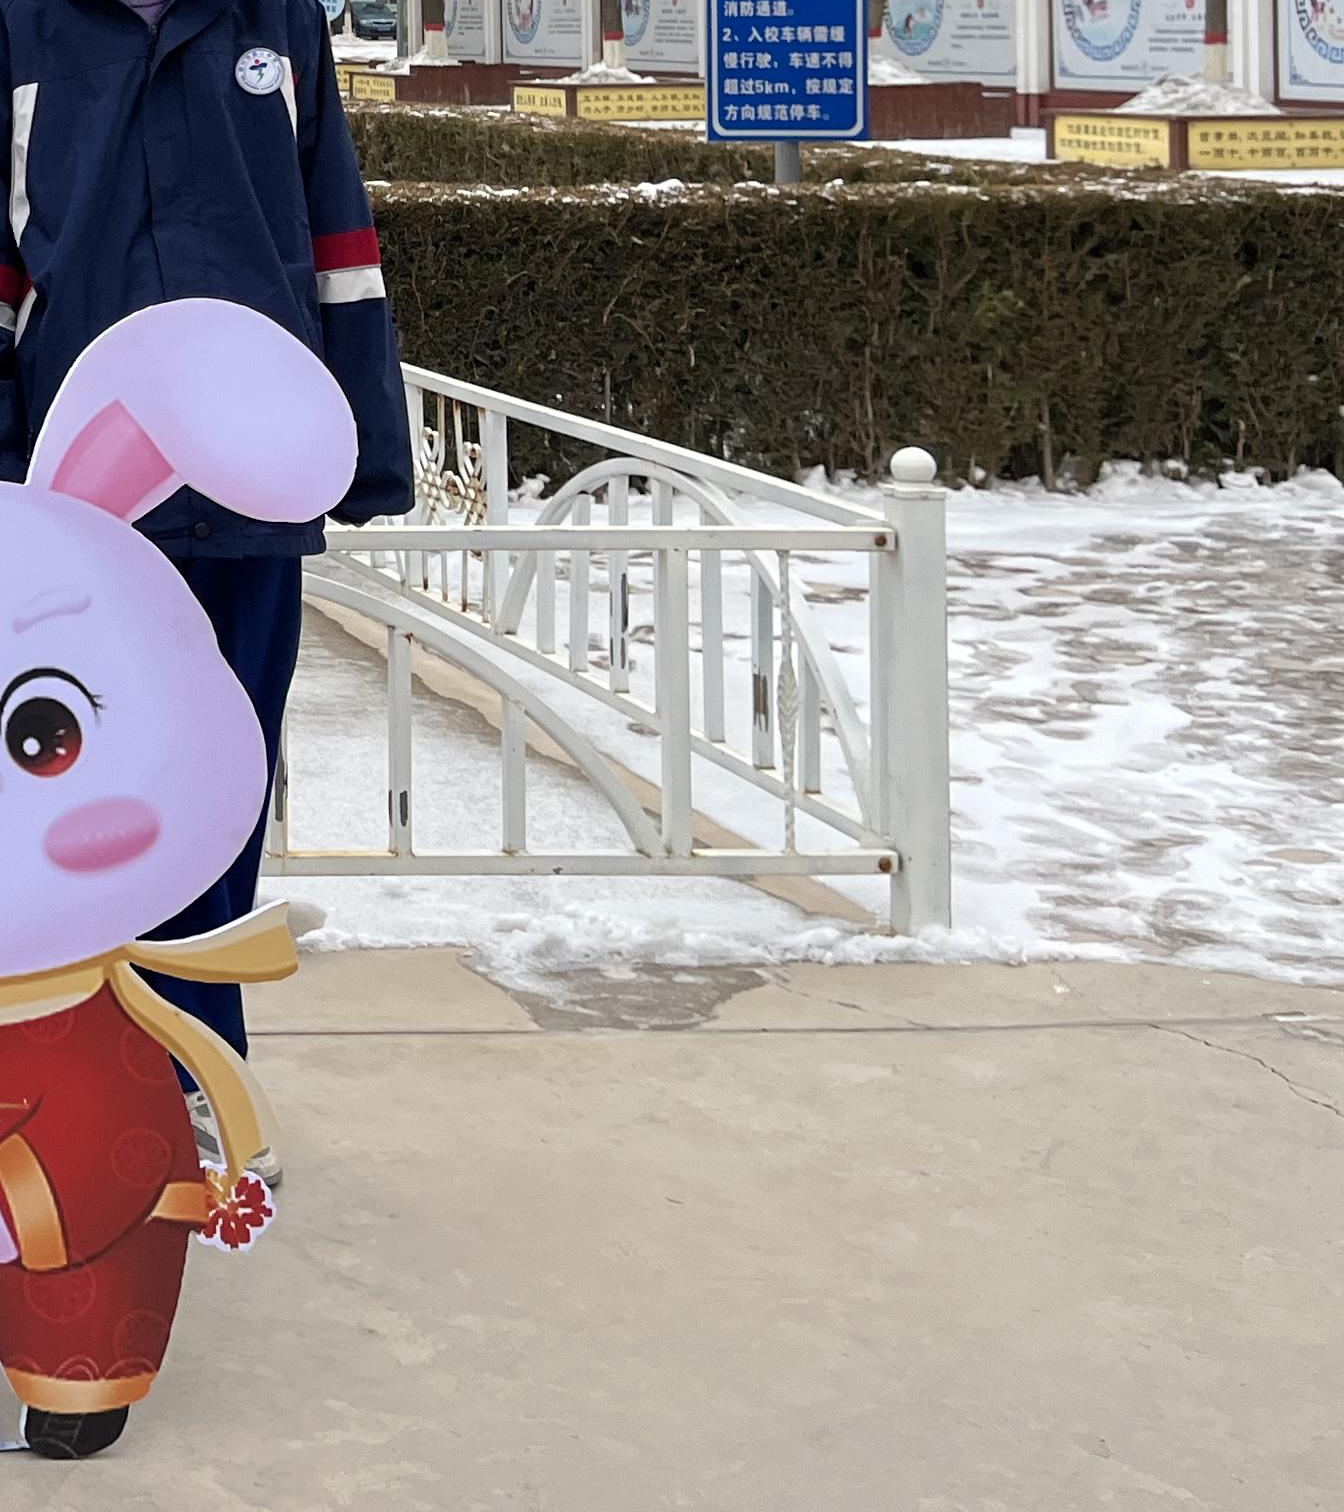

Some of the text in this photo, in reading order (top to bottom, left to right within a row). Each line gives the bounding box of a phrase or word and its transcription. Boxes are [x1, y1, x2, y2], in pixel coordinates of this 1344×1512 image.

[723, 0, 795, 17] 消防通道。
[723, 104, 830, 121] 方向规范停车。
